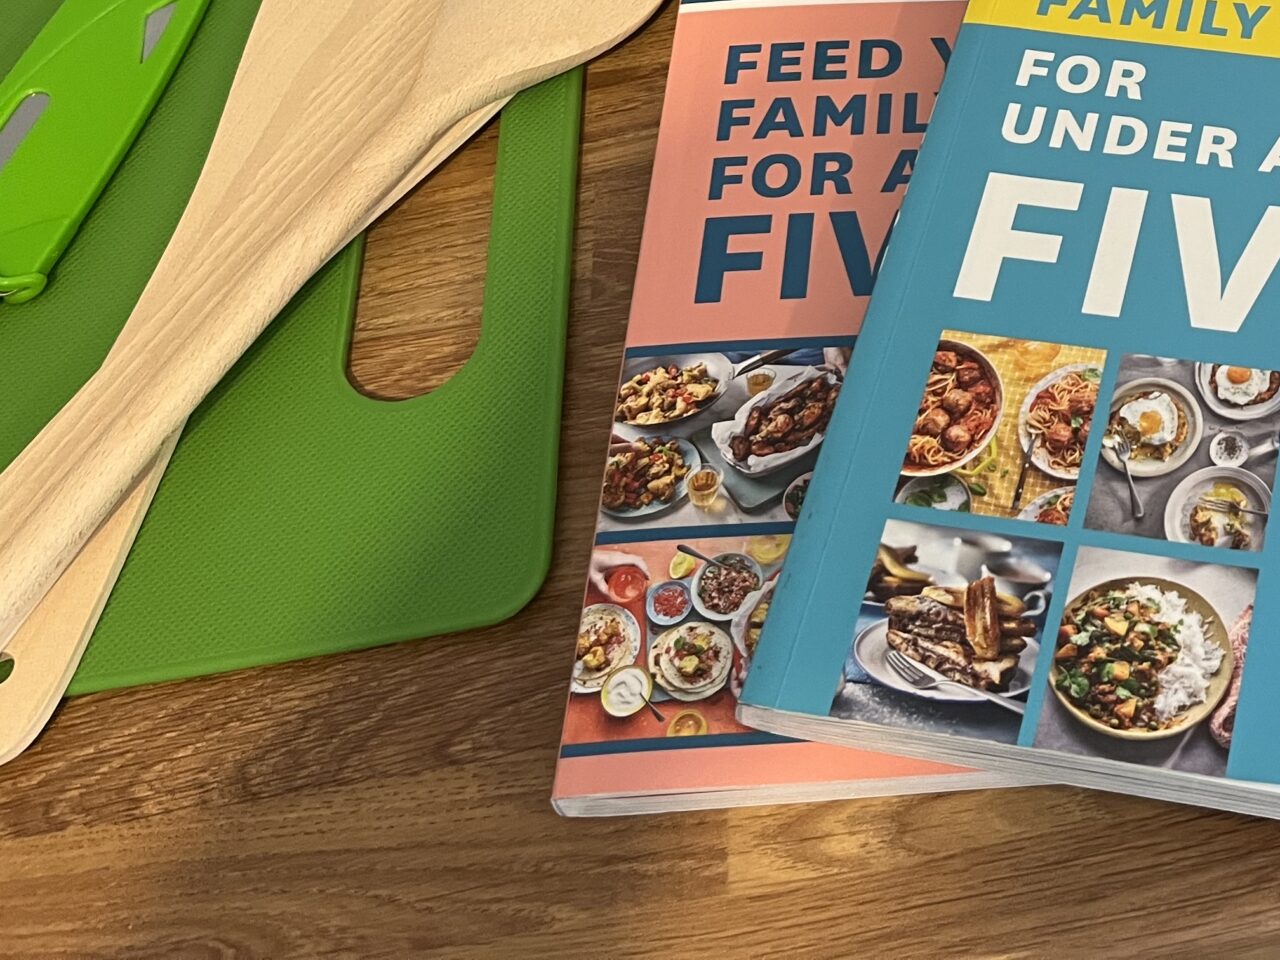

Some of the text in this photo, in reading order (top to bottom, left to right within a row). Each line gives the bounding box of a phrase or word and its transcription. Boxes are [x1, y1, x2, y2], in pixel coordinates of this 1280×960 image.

[723, 38, 904, 84] FEED
[1016, 48, 1147, 100] FOR
[716, 92, 938, 141] FAMIL
[1001, 102, 1238, 168] UNDER
[708, 151, 853, 200] FOR
[694, 209, 899, 304] FIV
